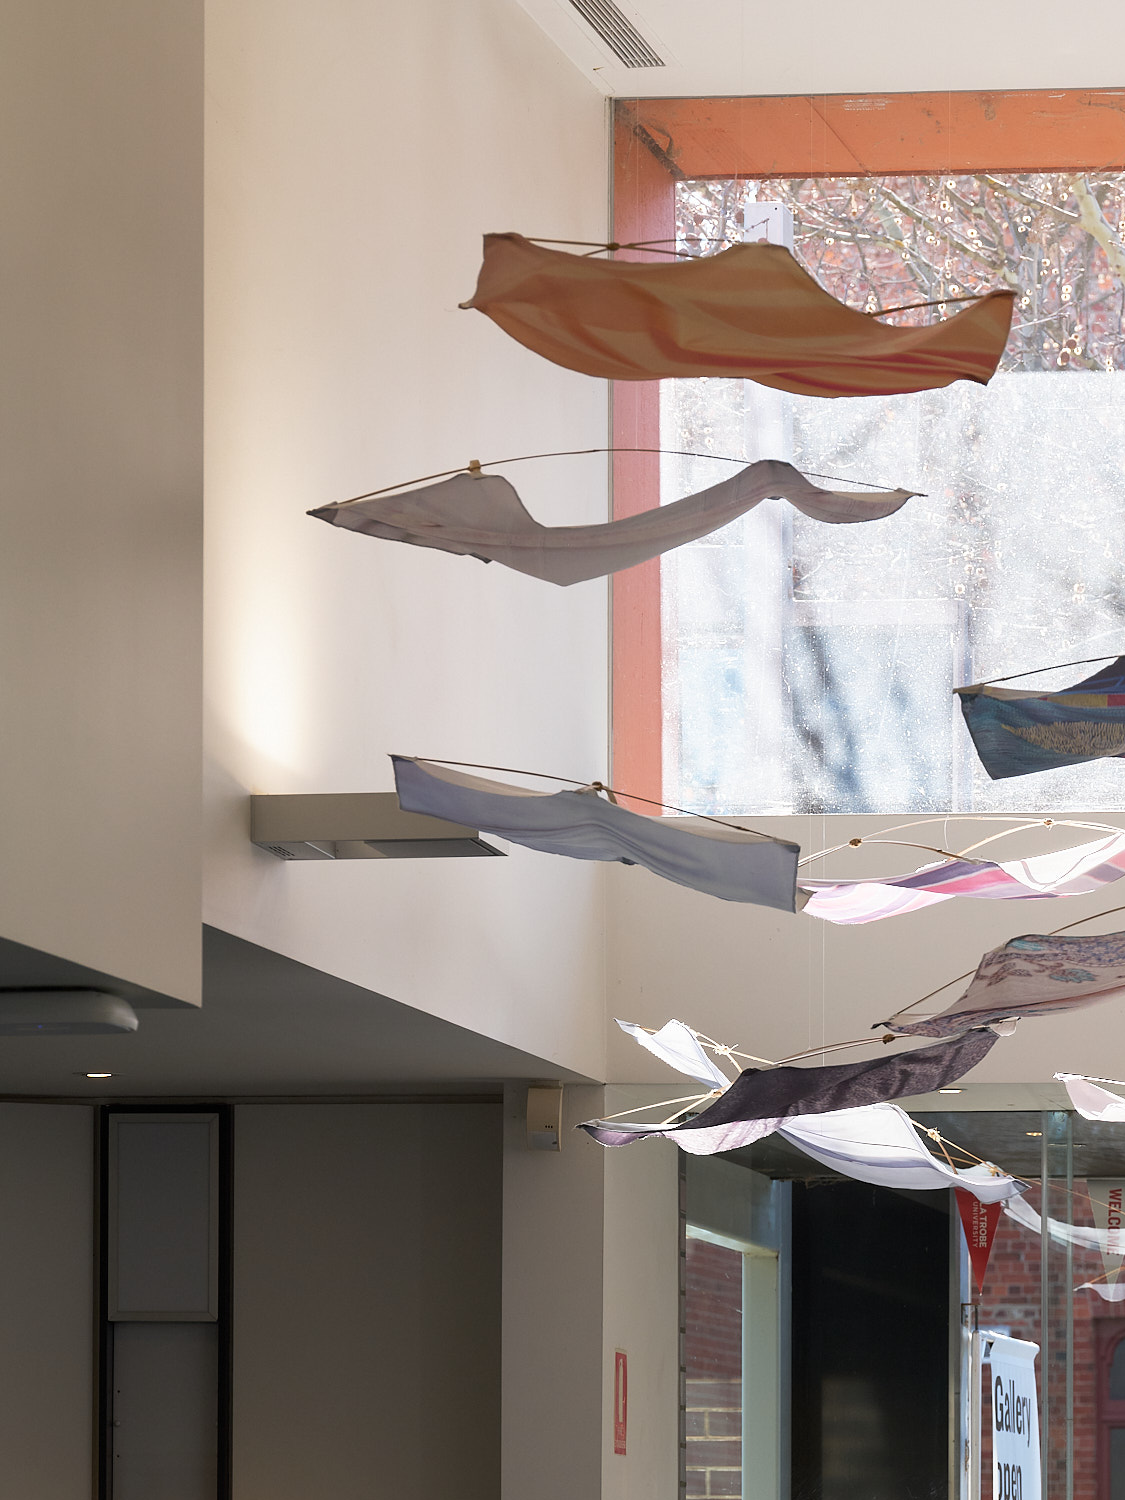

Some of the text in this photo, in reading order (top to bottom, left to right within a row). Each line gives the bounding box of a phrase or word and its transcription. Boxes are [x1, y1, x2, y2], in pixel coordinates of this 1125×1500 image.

[979, 1216, 987, 1248] TROBE
[1106, 1188, 1122, 1256] WELCOME
[995, 1375, 1031, 1448] Gallery
